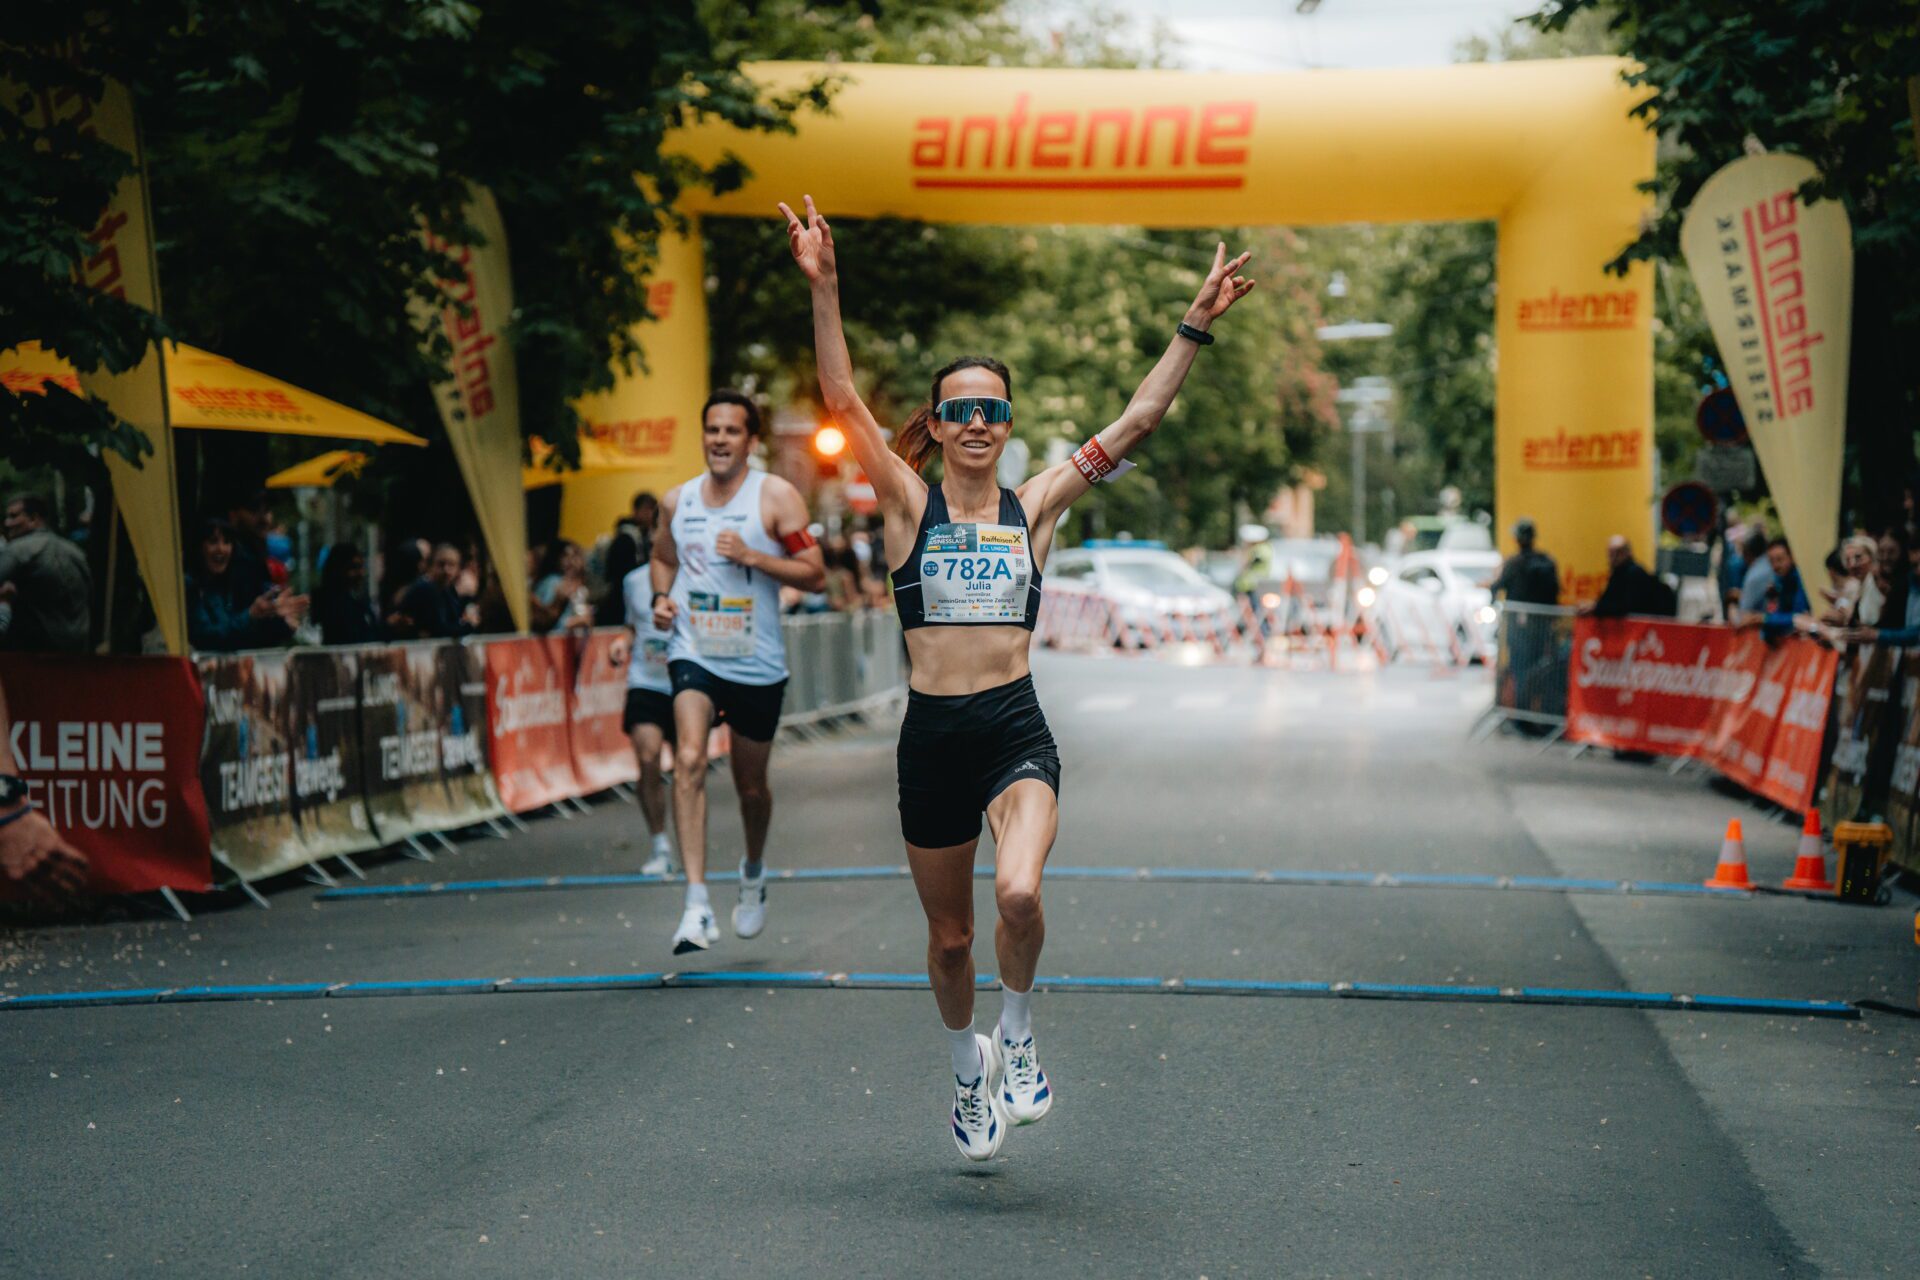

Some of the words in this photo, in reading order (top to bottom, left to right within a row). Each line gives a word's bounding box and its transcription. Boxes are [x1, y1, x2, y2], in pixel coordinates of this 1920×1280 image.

[911, 93, 1256, 169] antenne
[1518, 289, 1639, 323] antenne
[1523, 429, 1642, 462] antenne
[981, 535, 1013, 543] Raiffeisen
[943, 557, 1012, 580] 782A
[965, 581, 991, 591] Julia
[220, 752, 289, 812] TEAMGEIST
[27, 778, 167, 830] EITUNG
